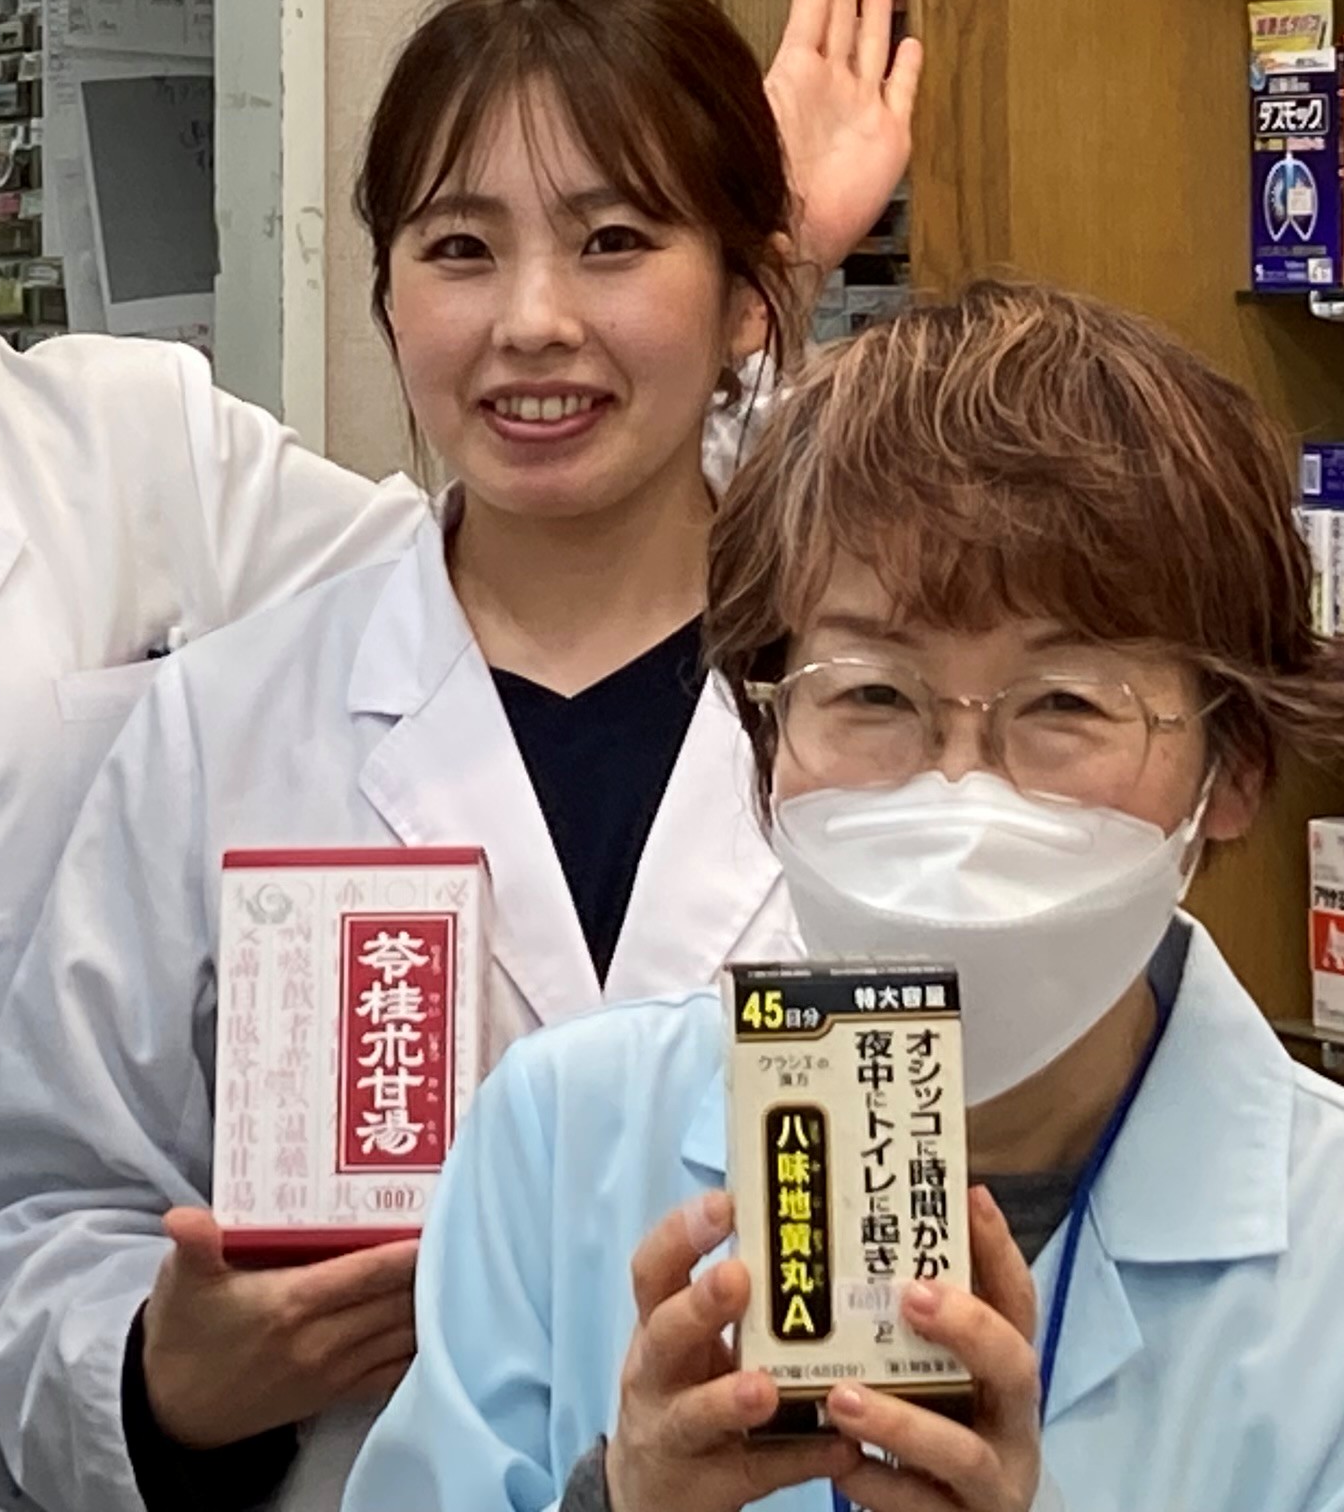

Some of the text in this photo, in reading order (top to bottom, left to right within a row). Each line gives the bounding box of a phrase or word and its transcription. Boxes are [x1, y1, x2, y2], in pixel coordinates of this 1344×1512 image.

[355, 931, 430, 1157] 苓桂朮甘湯
[855, 985, 947, 1010] 特大容量
[776, 1114, 816, 1335] 八味地黄丸A
